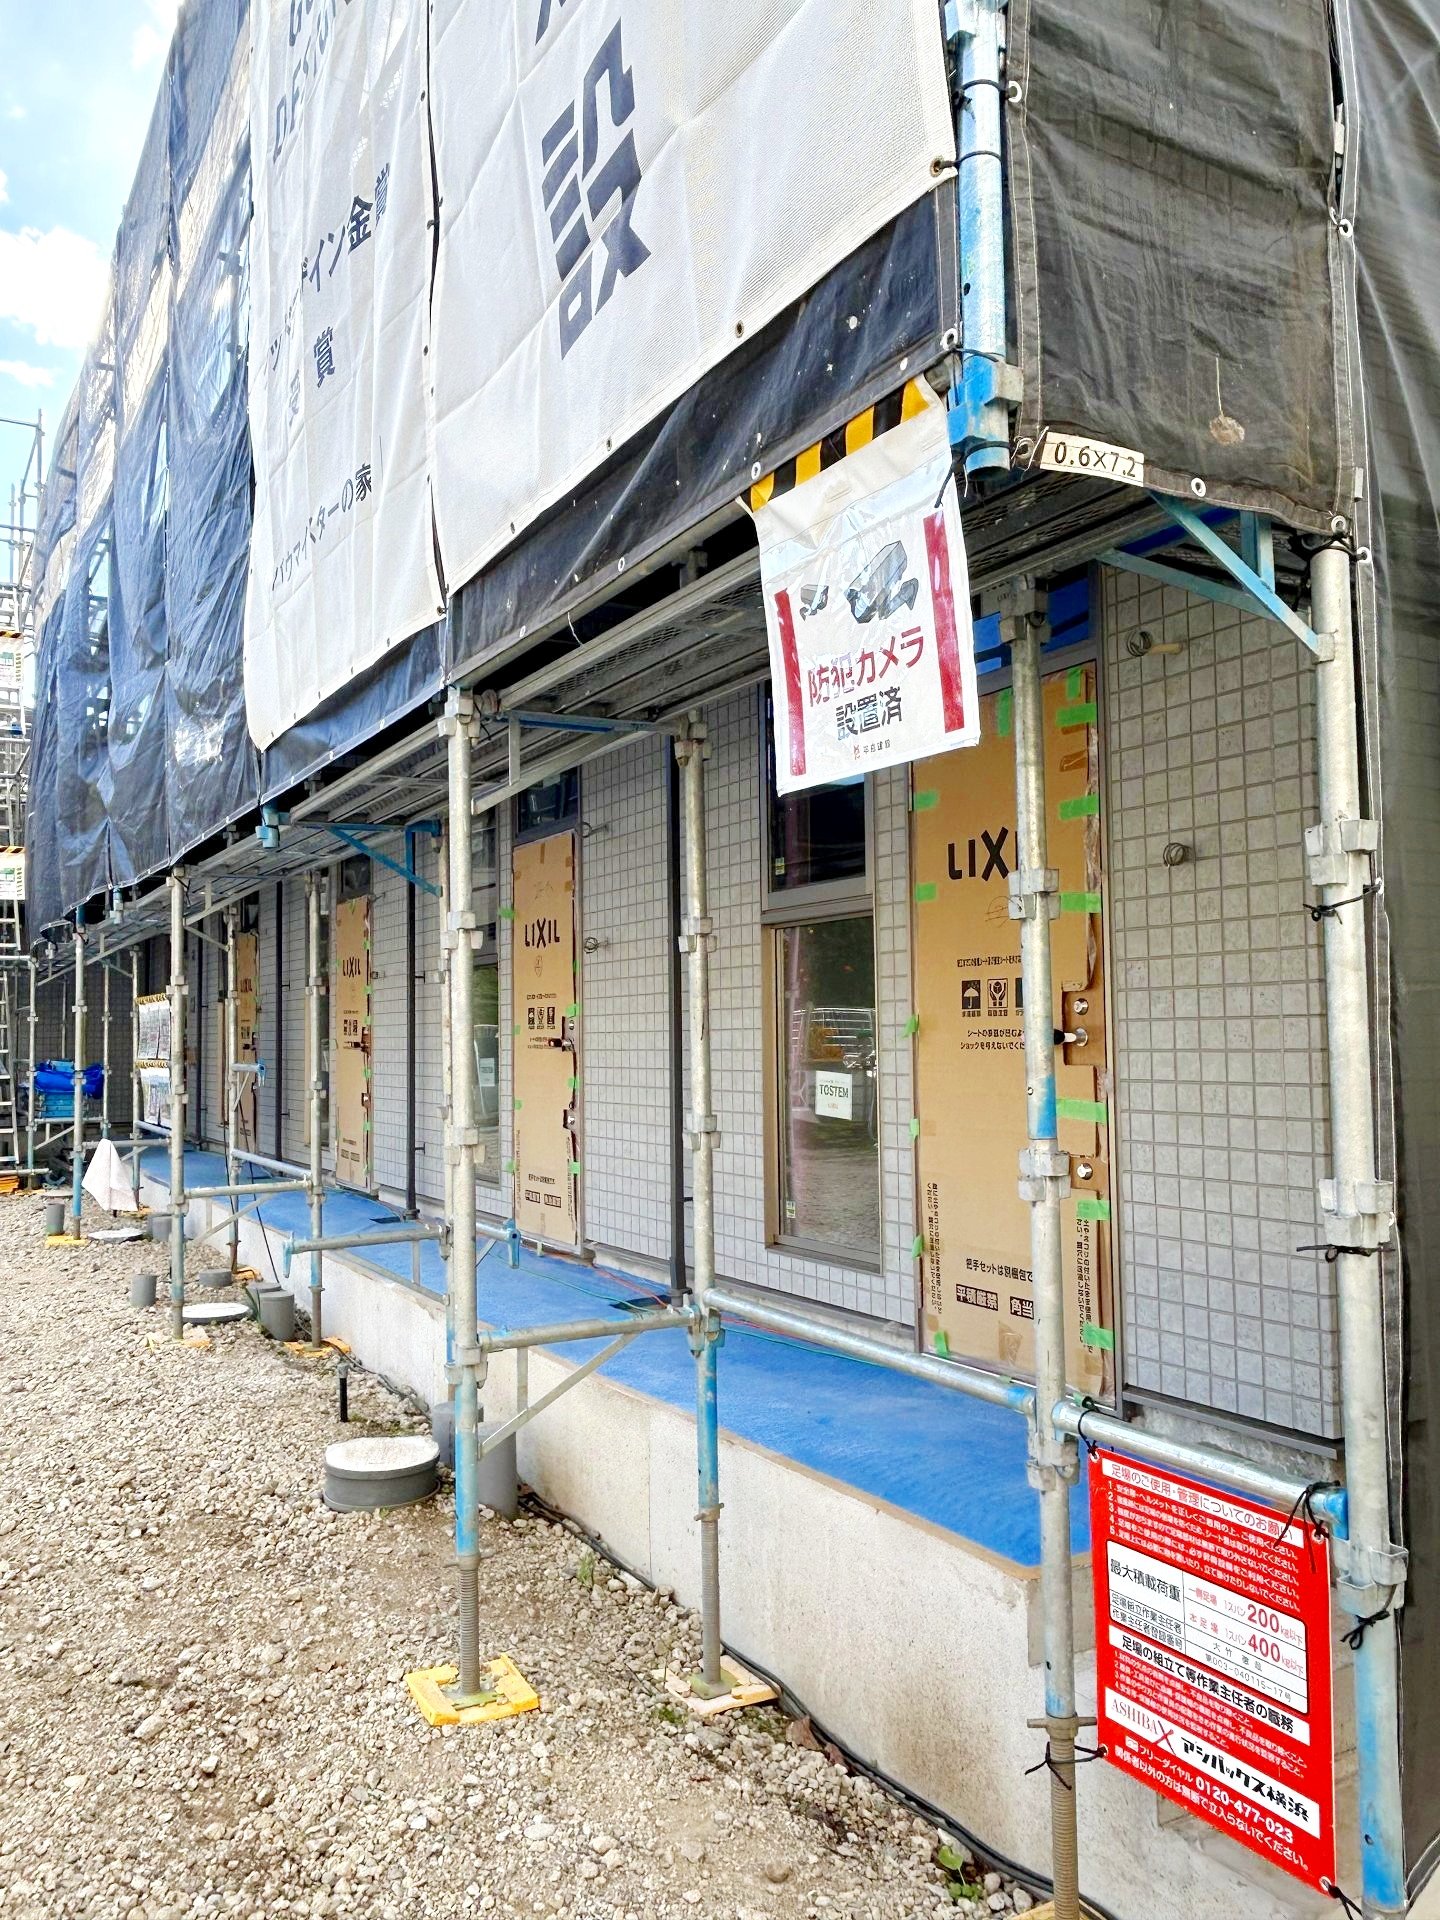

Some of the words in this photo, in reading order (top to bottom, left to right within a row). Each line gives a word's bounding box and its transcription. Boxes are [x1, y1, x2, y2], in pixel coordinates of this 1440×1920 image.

[808, 626, 924, 707] 防犯カメラ
[836, 686, 903, 741] 設置済
[525, 917, 560, 948] LIXIL
[820, 1084, 849, 1098] TOSTEM
[1196, 1774, 1293, 1844] 0120-477-023
